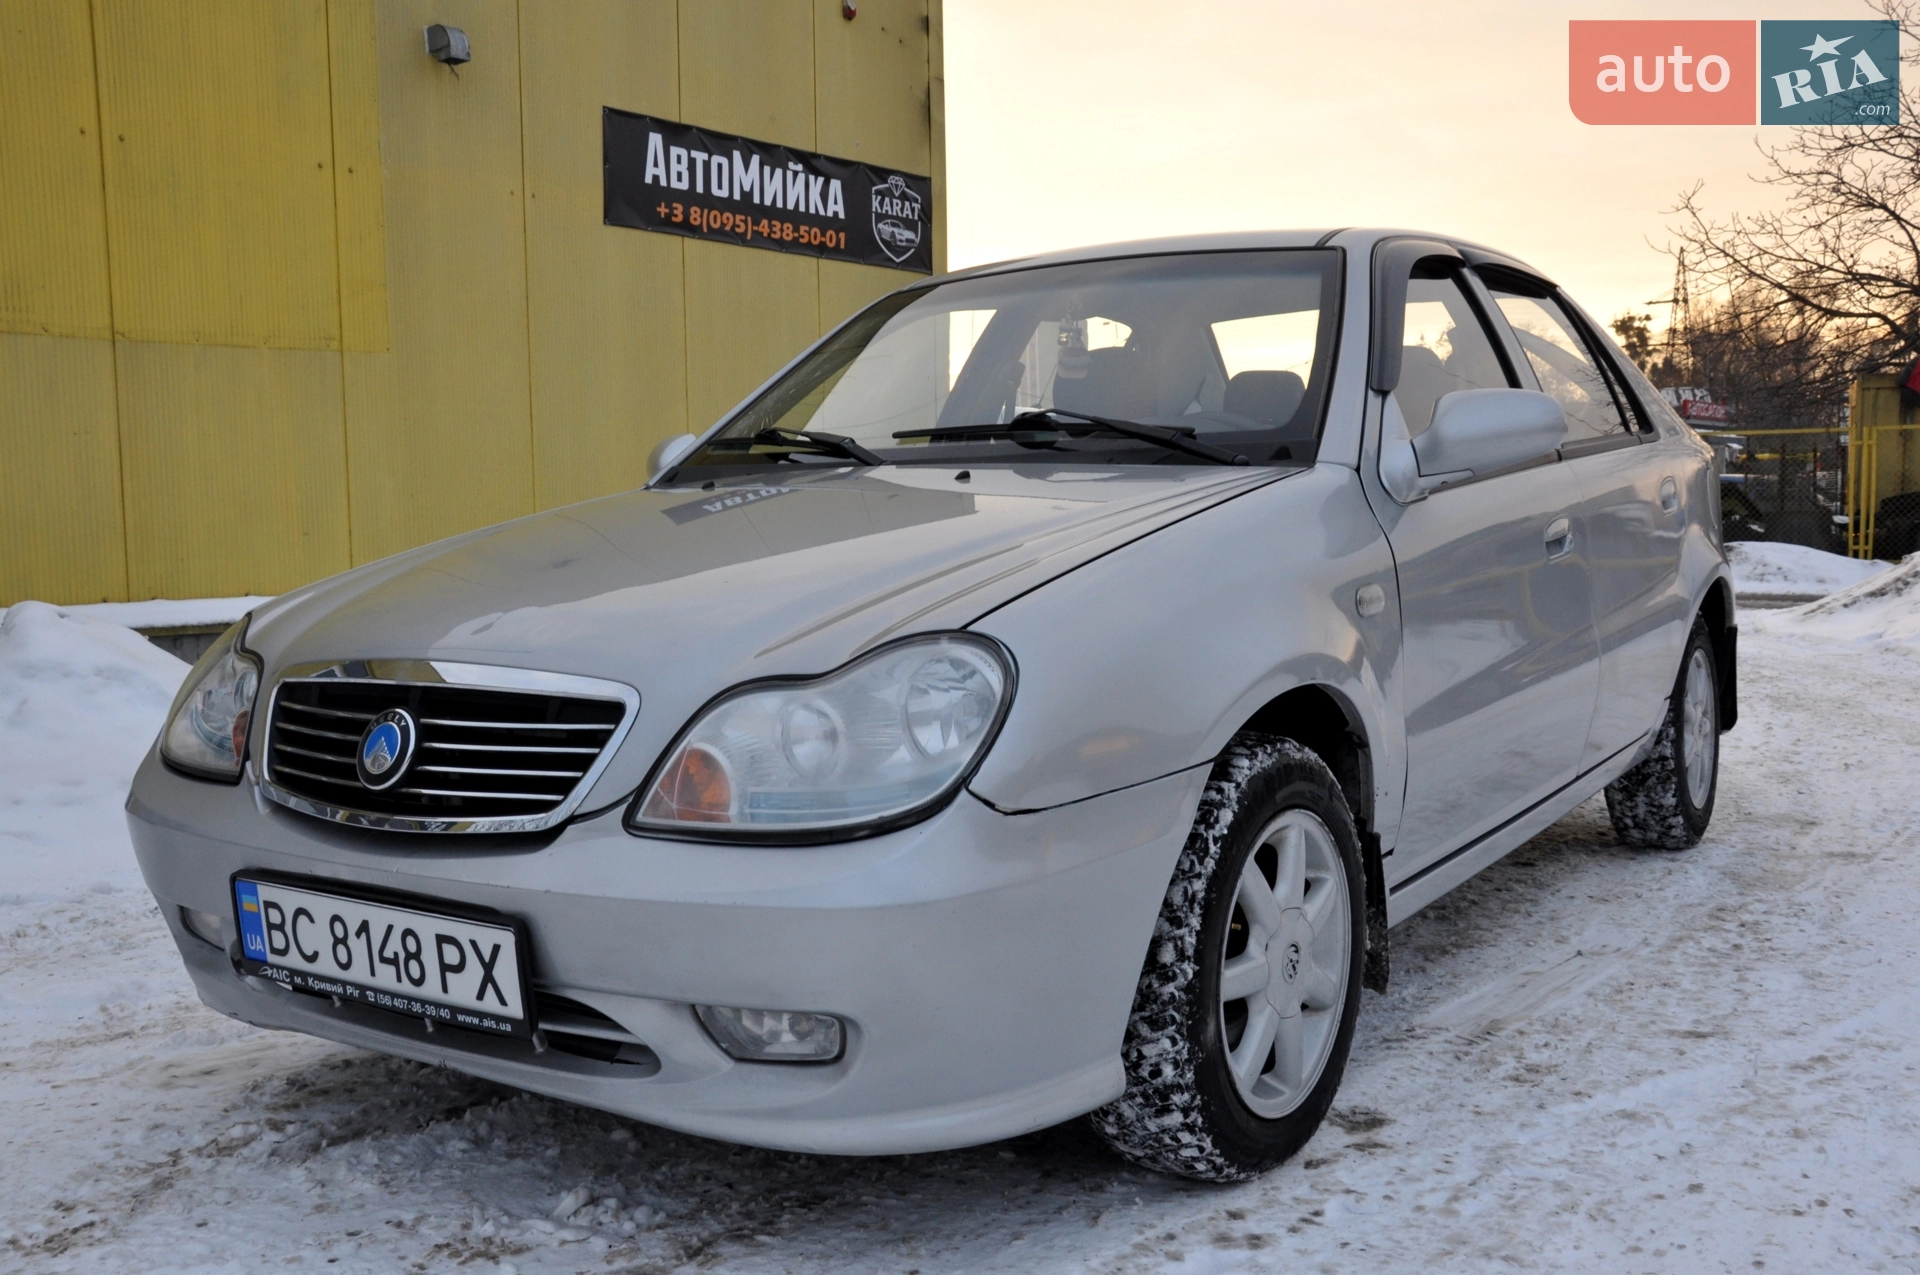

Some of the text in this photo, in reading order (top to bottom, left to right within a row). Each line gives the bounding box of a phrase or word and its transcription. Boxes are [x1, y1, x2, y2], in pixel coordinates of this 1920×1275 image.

[872, 194, 921, 220] KARAT
[246, 933, 265, 953] UA
[328, 913, 427, 988] 8148
[307, 976, 344, 994] Кривий
[456, 1013, 512, 1032] www.ais.ua
